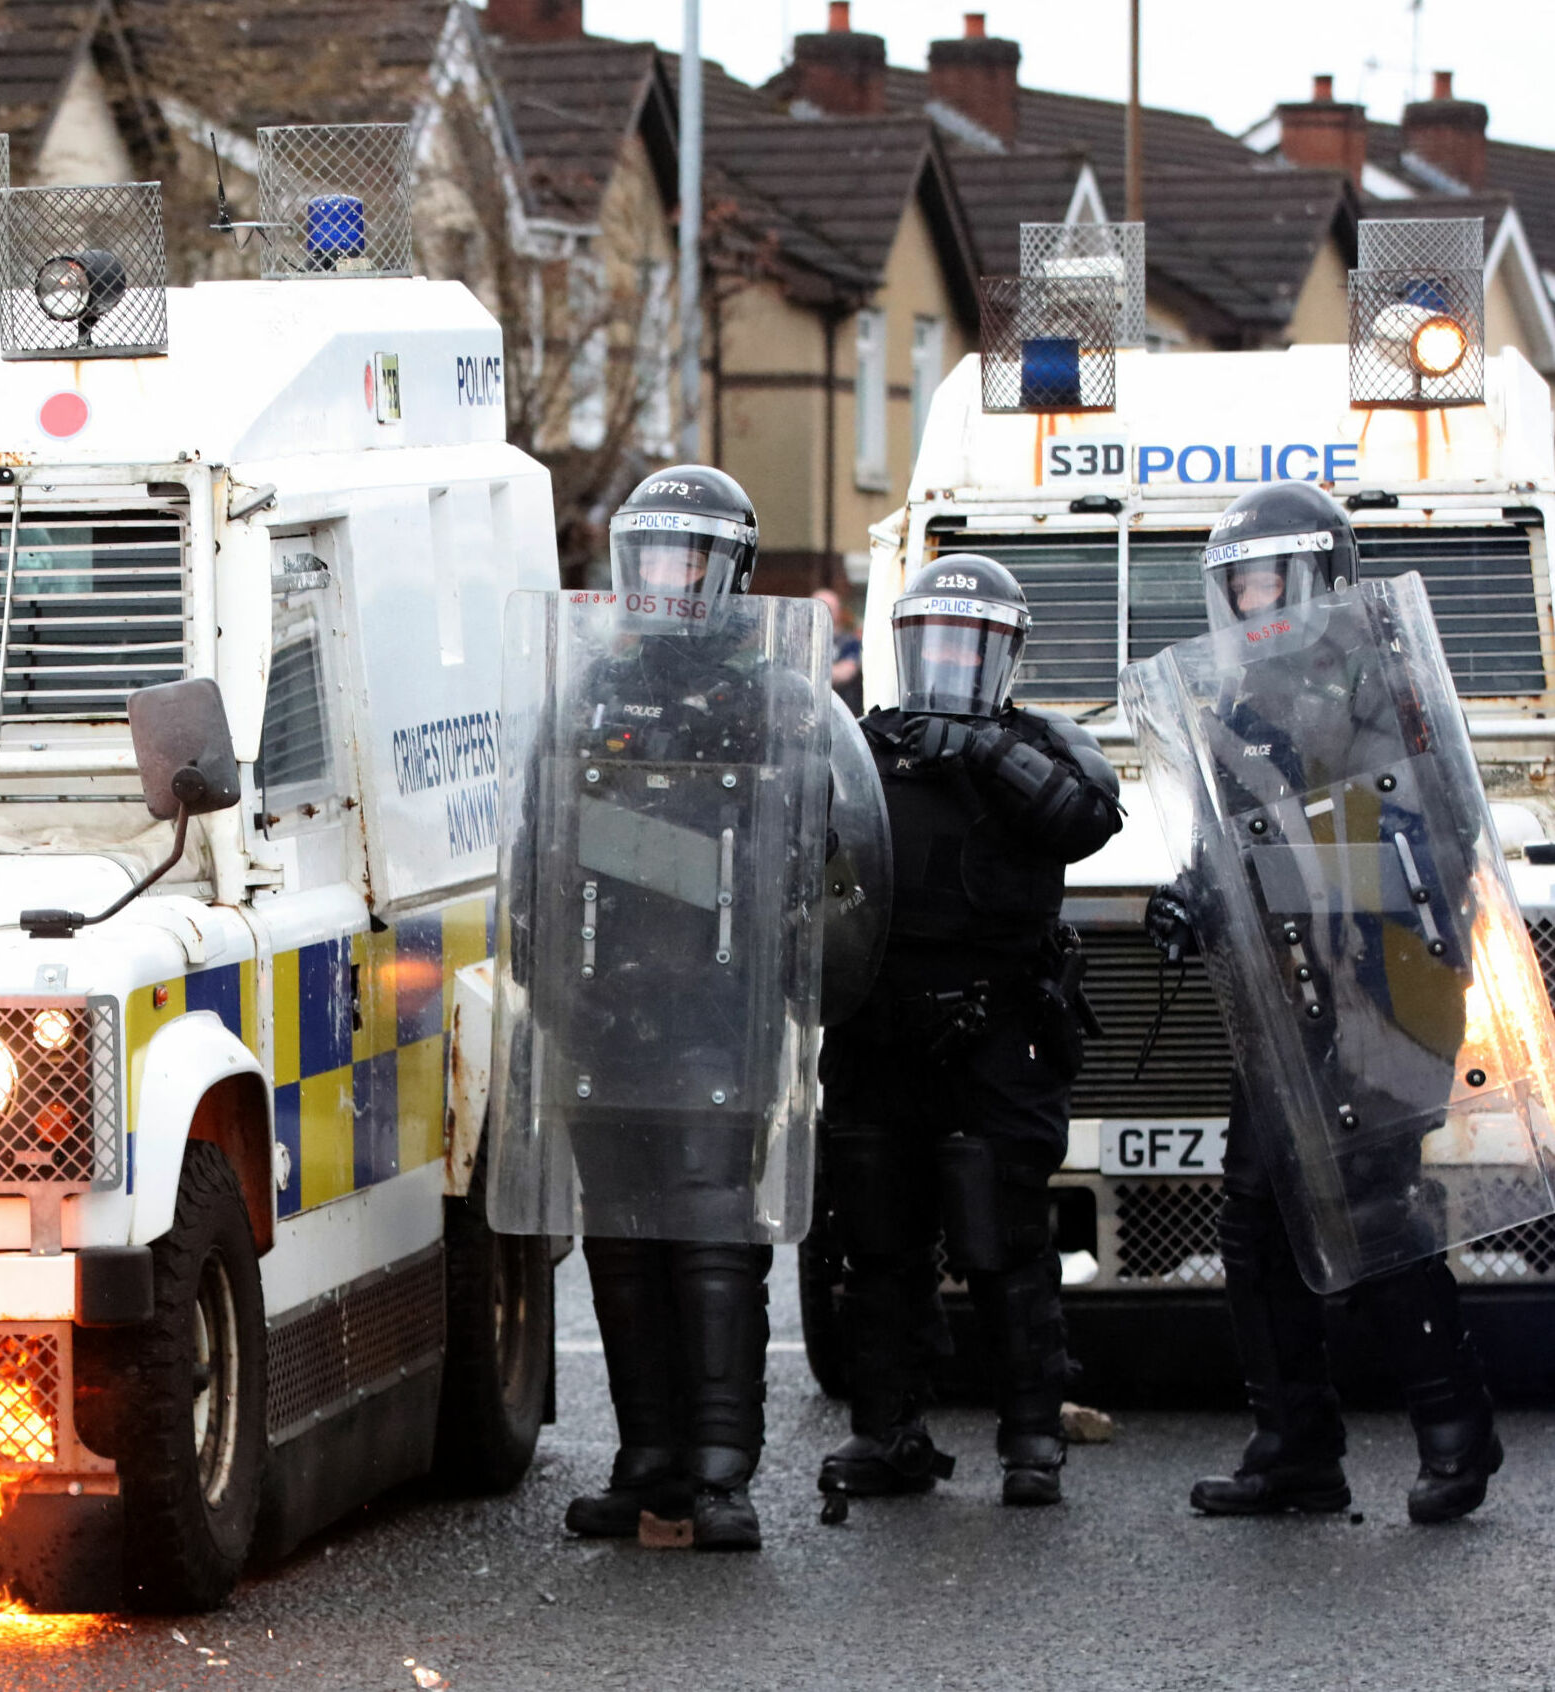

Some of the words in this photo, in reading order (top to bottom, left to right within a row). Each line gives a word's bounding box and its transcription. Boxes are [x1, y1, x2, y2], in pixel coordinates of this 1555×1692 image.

[457, 356, 502, 405] POLICE
[1049, 443, 1125, 476] S3D
[1138, 443, 1360, 484] POLICE
[647, 480, 688, 496] 6773
[638, 513, 680, 529] POLICE
[1206, 543, 1239, 563] POLICE
[935, 574, 978, 590] 2193
[664, 596, 707, 620] TSG
[930, 598, 973, 615] POLICE
[1270, 619, 1291, 635] TSG
[624, 704, 663, 718] POLICE
[393, 710, 496, 797] CRIMESTOPPERS
[1243, 744, 1272, 757] POLICE
[1119, 1128, 1204, 1168] GFZ
